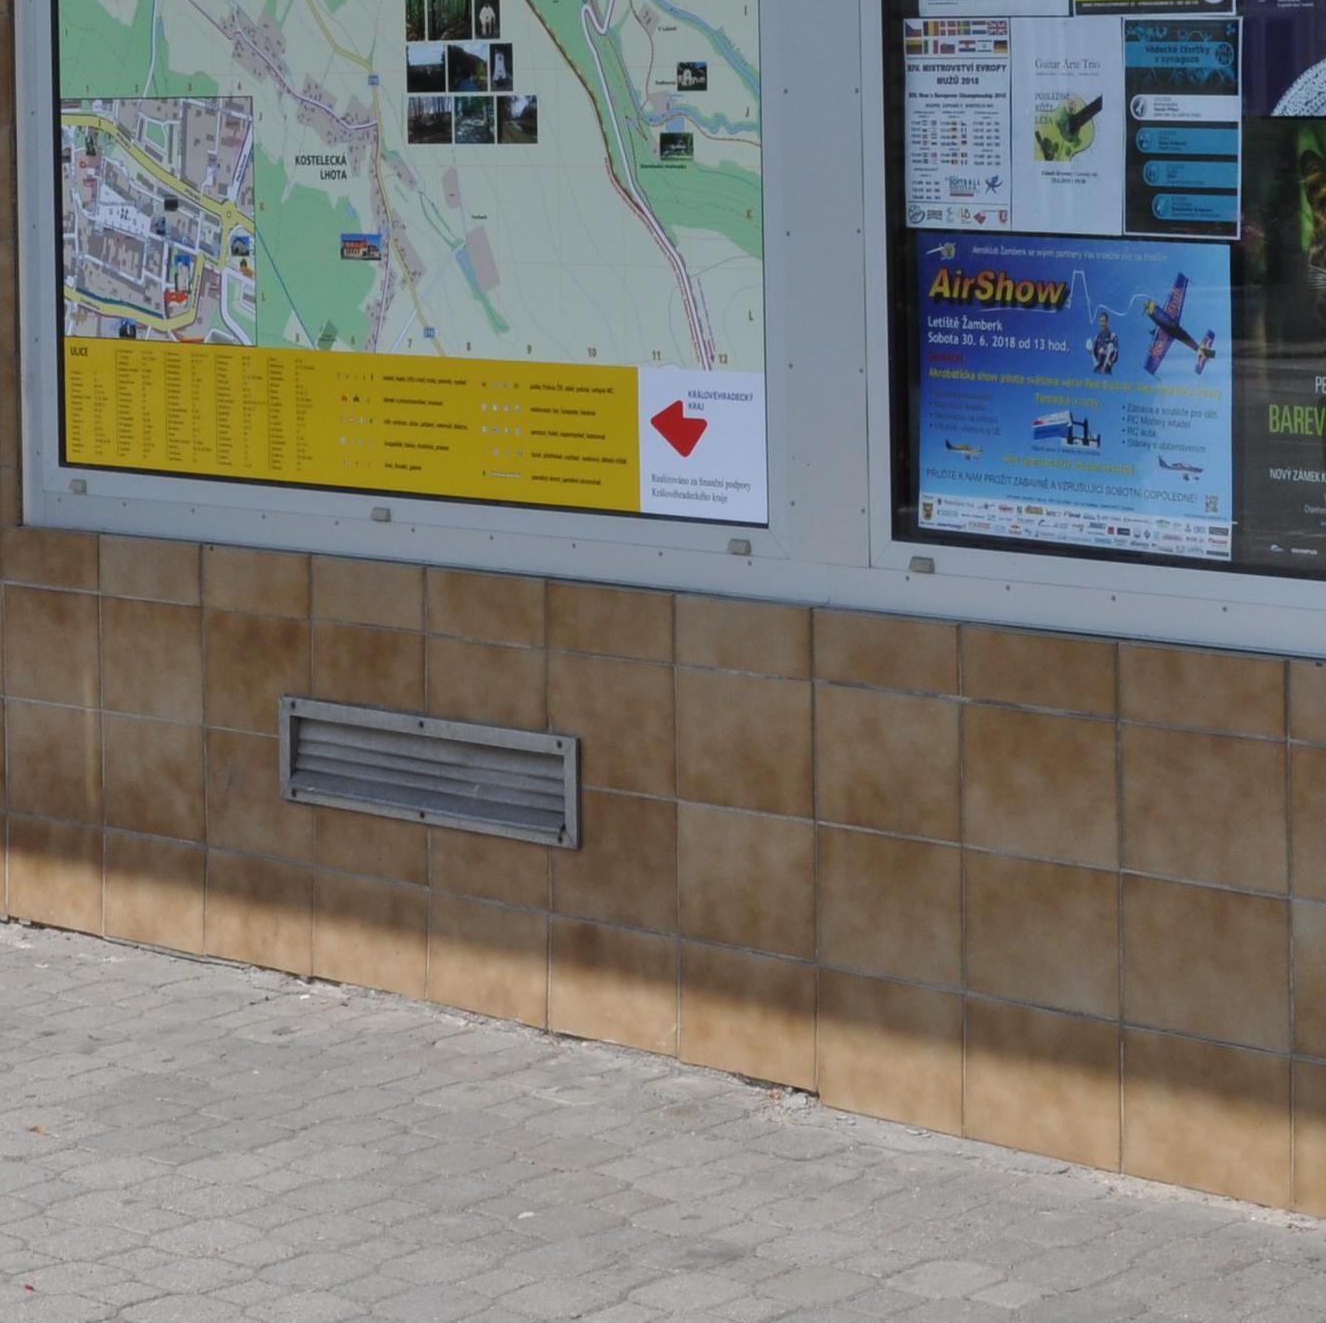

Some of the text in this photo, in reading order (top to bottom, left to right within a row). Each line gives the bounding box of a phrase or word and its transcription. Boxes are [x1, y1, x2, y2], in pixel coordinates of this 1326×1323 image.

[295, 153, 347, 166] KOSTELECKÁ
[320, 168, 347, 181] LHOTA
[928, 268, 1068, 307] AirShow
[928, 315, 1003, 332] Letiště Žamberk
[928, 332, 1070, 352] Sobota 30. 6. 2018 od 13 hod.
[70, 346, 88, 357] ULICE
[1269, 467, 1292, 480] NOVÝ
[1293, 469, 1320, 483] ZÁMEK
